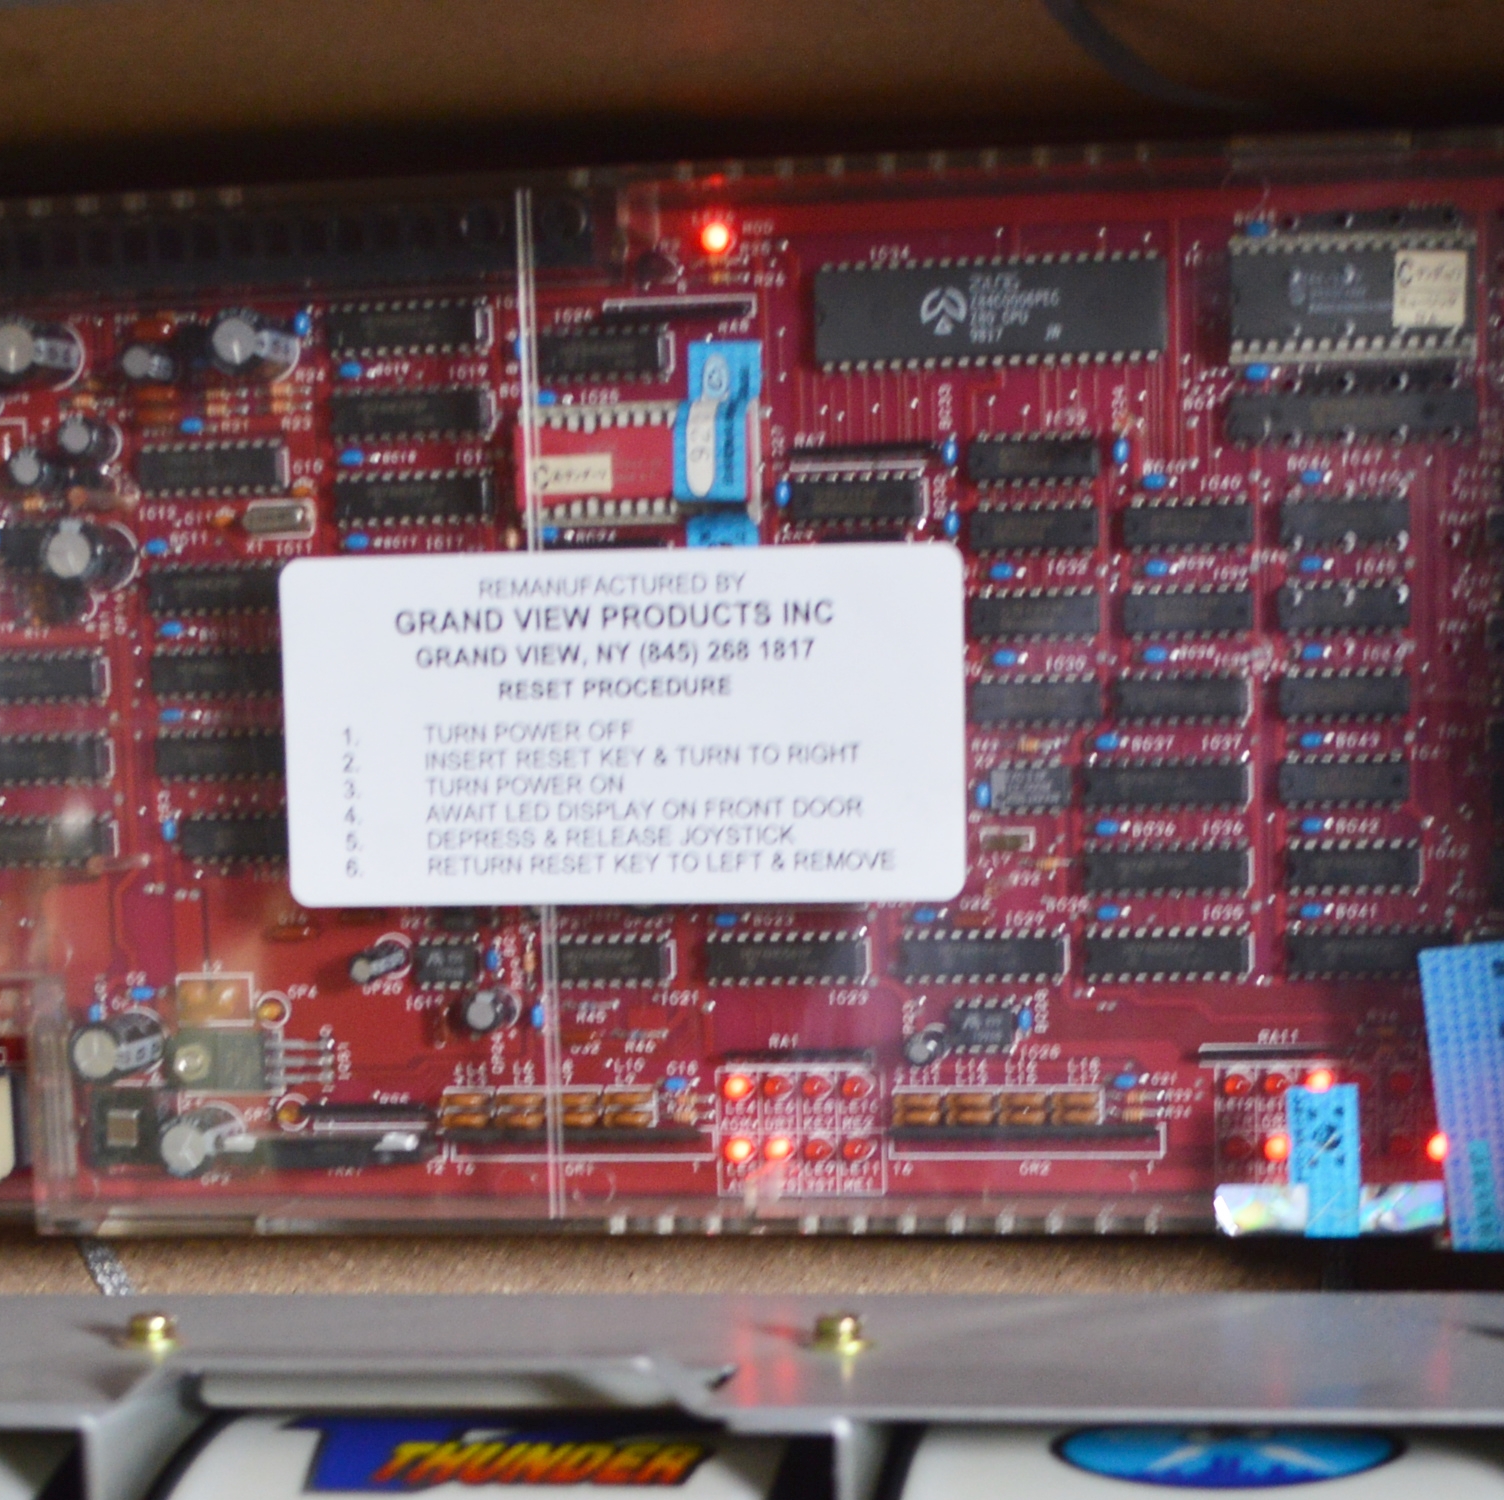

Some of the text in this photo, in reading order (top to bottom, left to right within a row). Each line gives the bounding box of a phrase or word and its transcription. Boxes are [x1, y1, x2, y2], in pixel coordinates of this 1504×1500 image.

[479, 573, 745, 597] REMANUFACTURED BY
[395, 601, 834, 633] GRAND VIEW PRODUCTS INC
[416, 638, 815, 666] GRAND VIEW, NY (845) 268 1817
[499, 677, 731, 699] RESET PROCEDURE
[343, 720, 633, 744] 1. TURN POWER OFF
[343, 743, 860, 772] 2. INSERT RESET KEY & TURN TO RIGHT
[344, 775, 625, 798] 3. TURN POWER ON
[344, 798, 863, 823] 4. AWAIT LED DISPLAY ON FRONT DOOR
[346, 825, 794, 851] 5. DEPRESS & RELEASE JOYSTICK
[346, 851, 893, 877] 6. RETURN RESET KEY TO LEFT & REMOVE
[373, 1437, 712, 1487] THUNDER
